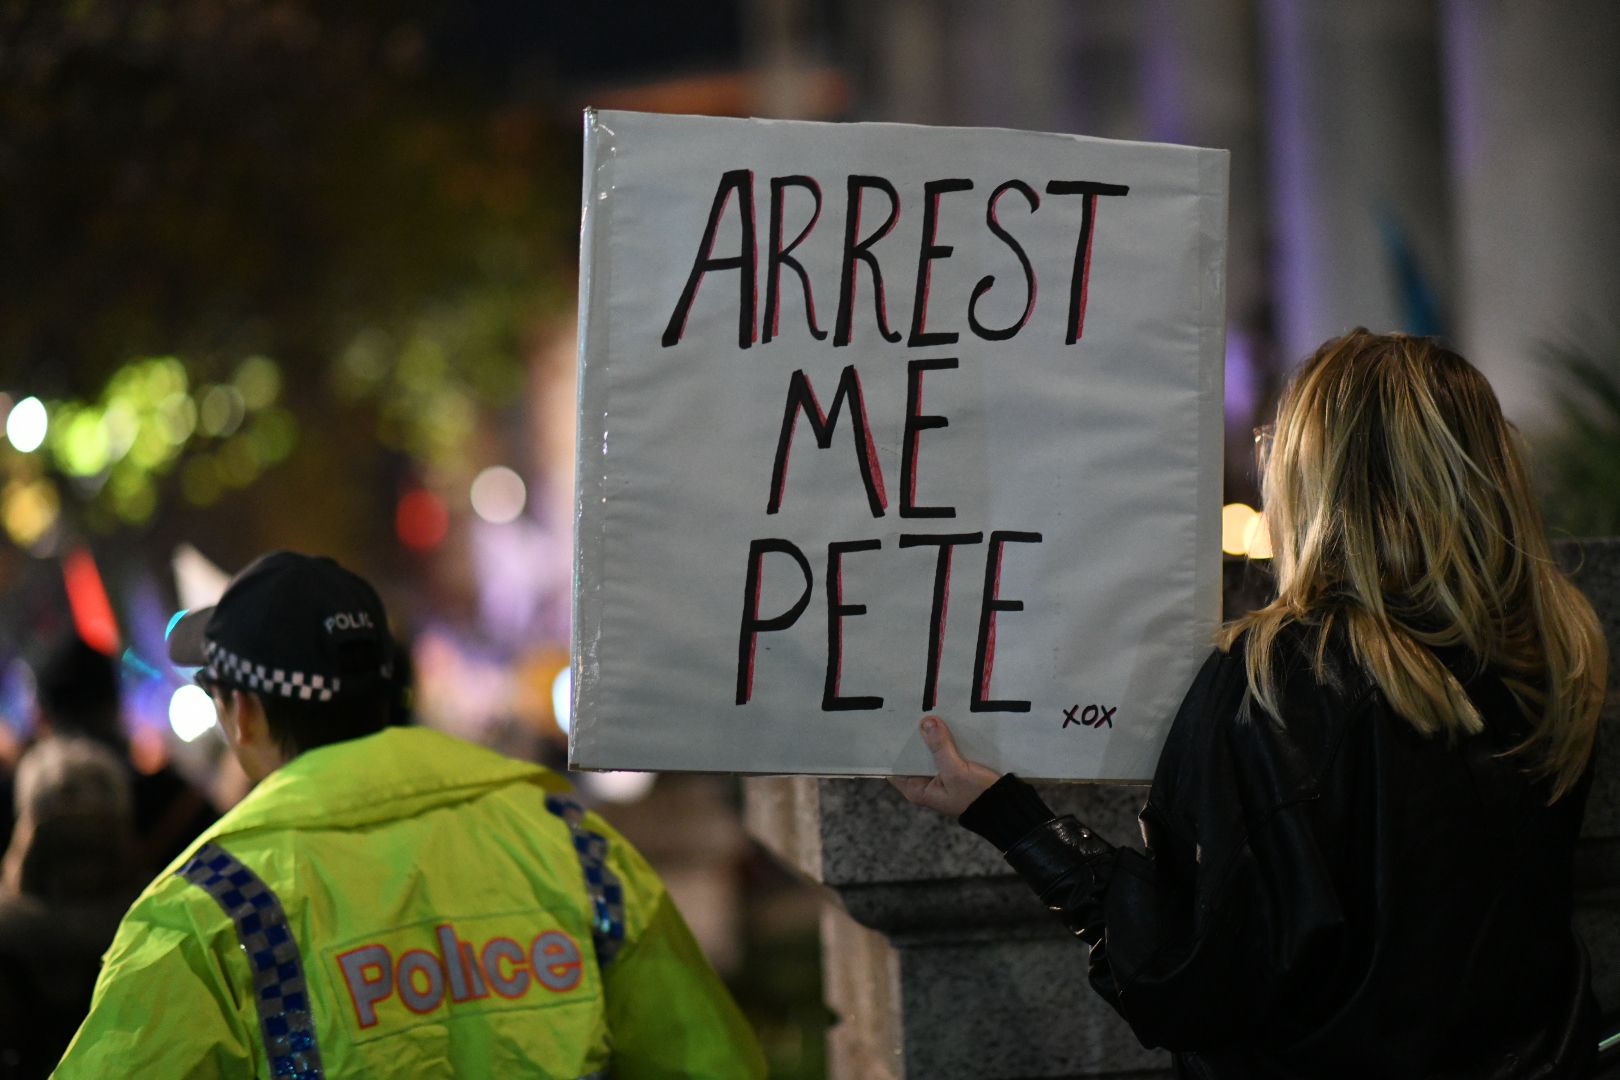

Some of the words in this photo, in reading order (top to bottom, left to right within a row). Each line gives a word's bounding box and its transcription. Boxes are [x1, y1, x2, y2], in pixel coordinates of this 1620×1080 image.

[661, 168, 1131, 350] ARREST
[766, 357, 959, 519] ME
[735, 530, 1043, 714] PETE
[336, 923, 583, 1029] Police
